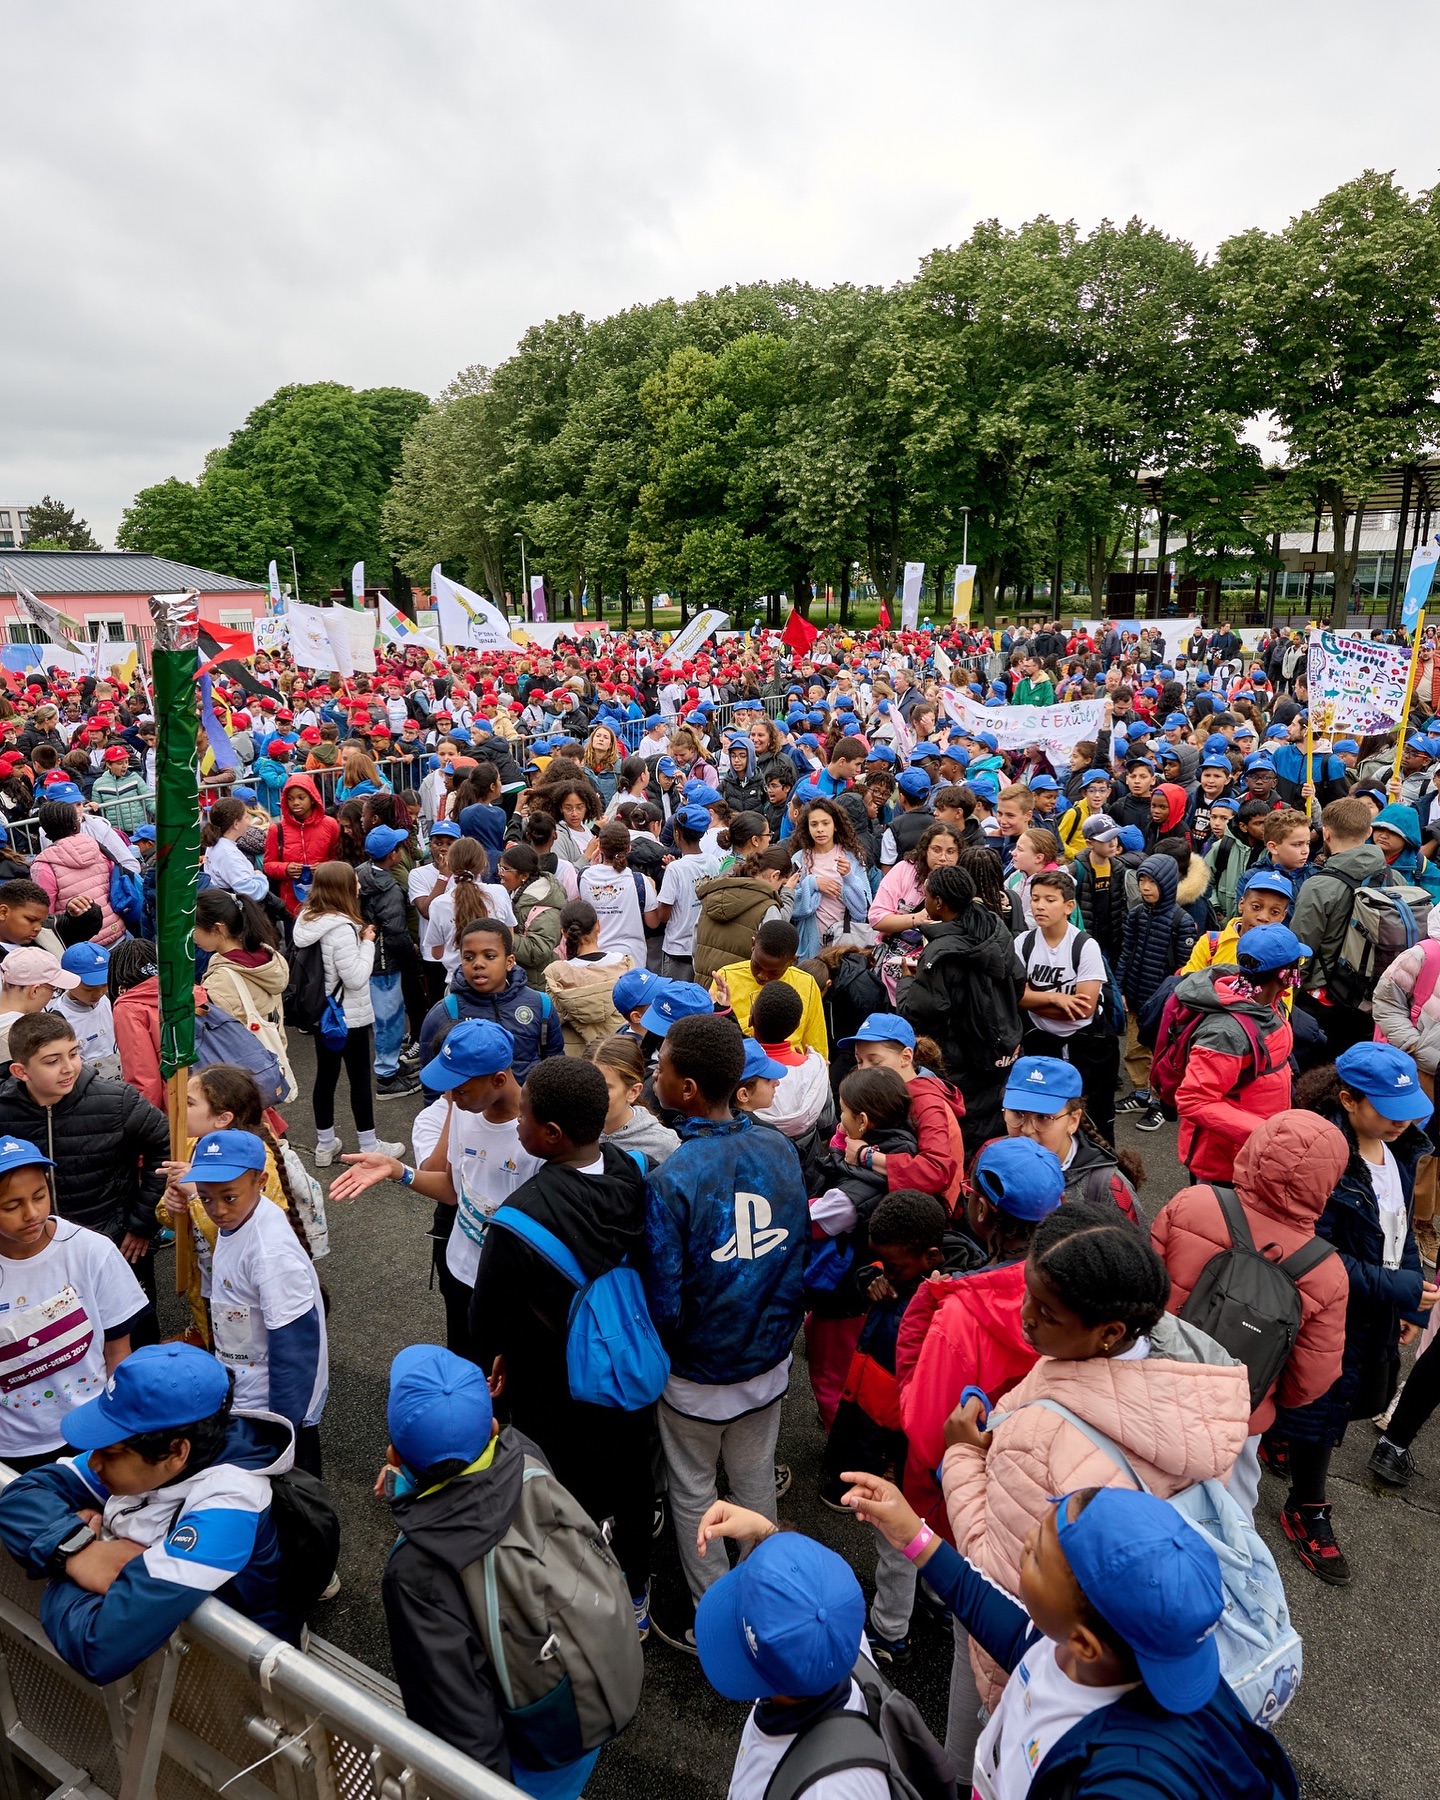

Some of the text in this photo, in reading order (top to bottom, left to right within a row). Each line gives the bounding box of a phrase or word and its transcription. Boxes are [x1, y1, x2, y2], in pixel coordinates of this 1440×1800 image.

[1032, 964, 1066, 984] NIKE
[8, 1353, 72, 1385] SEINE-SAINT-DENIS
[71, 1342, 88, 1357] 2024
